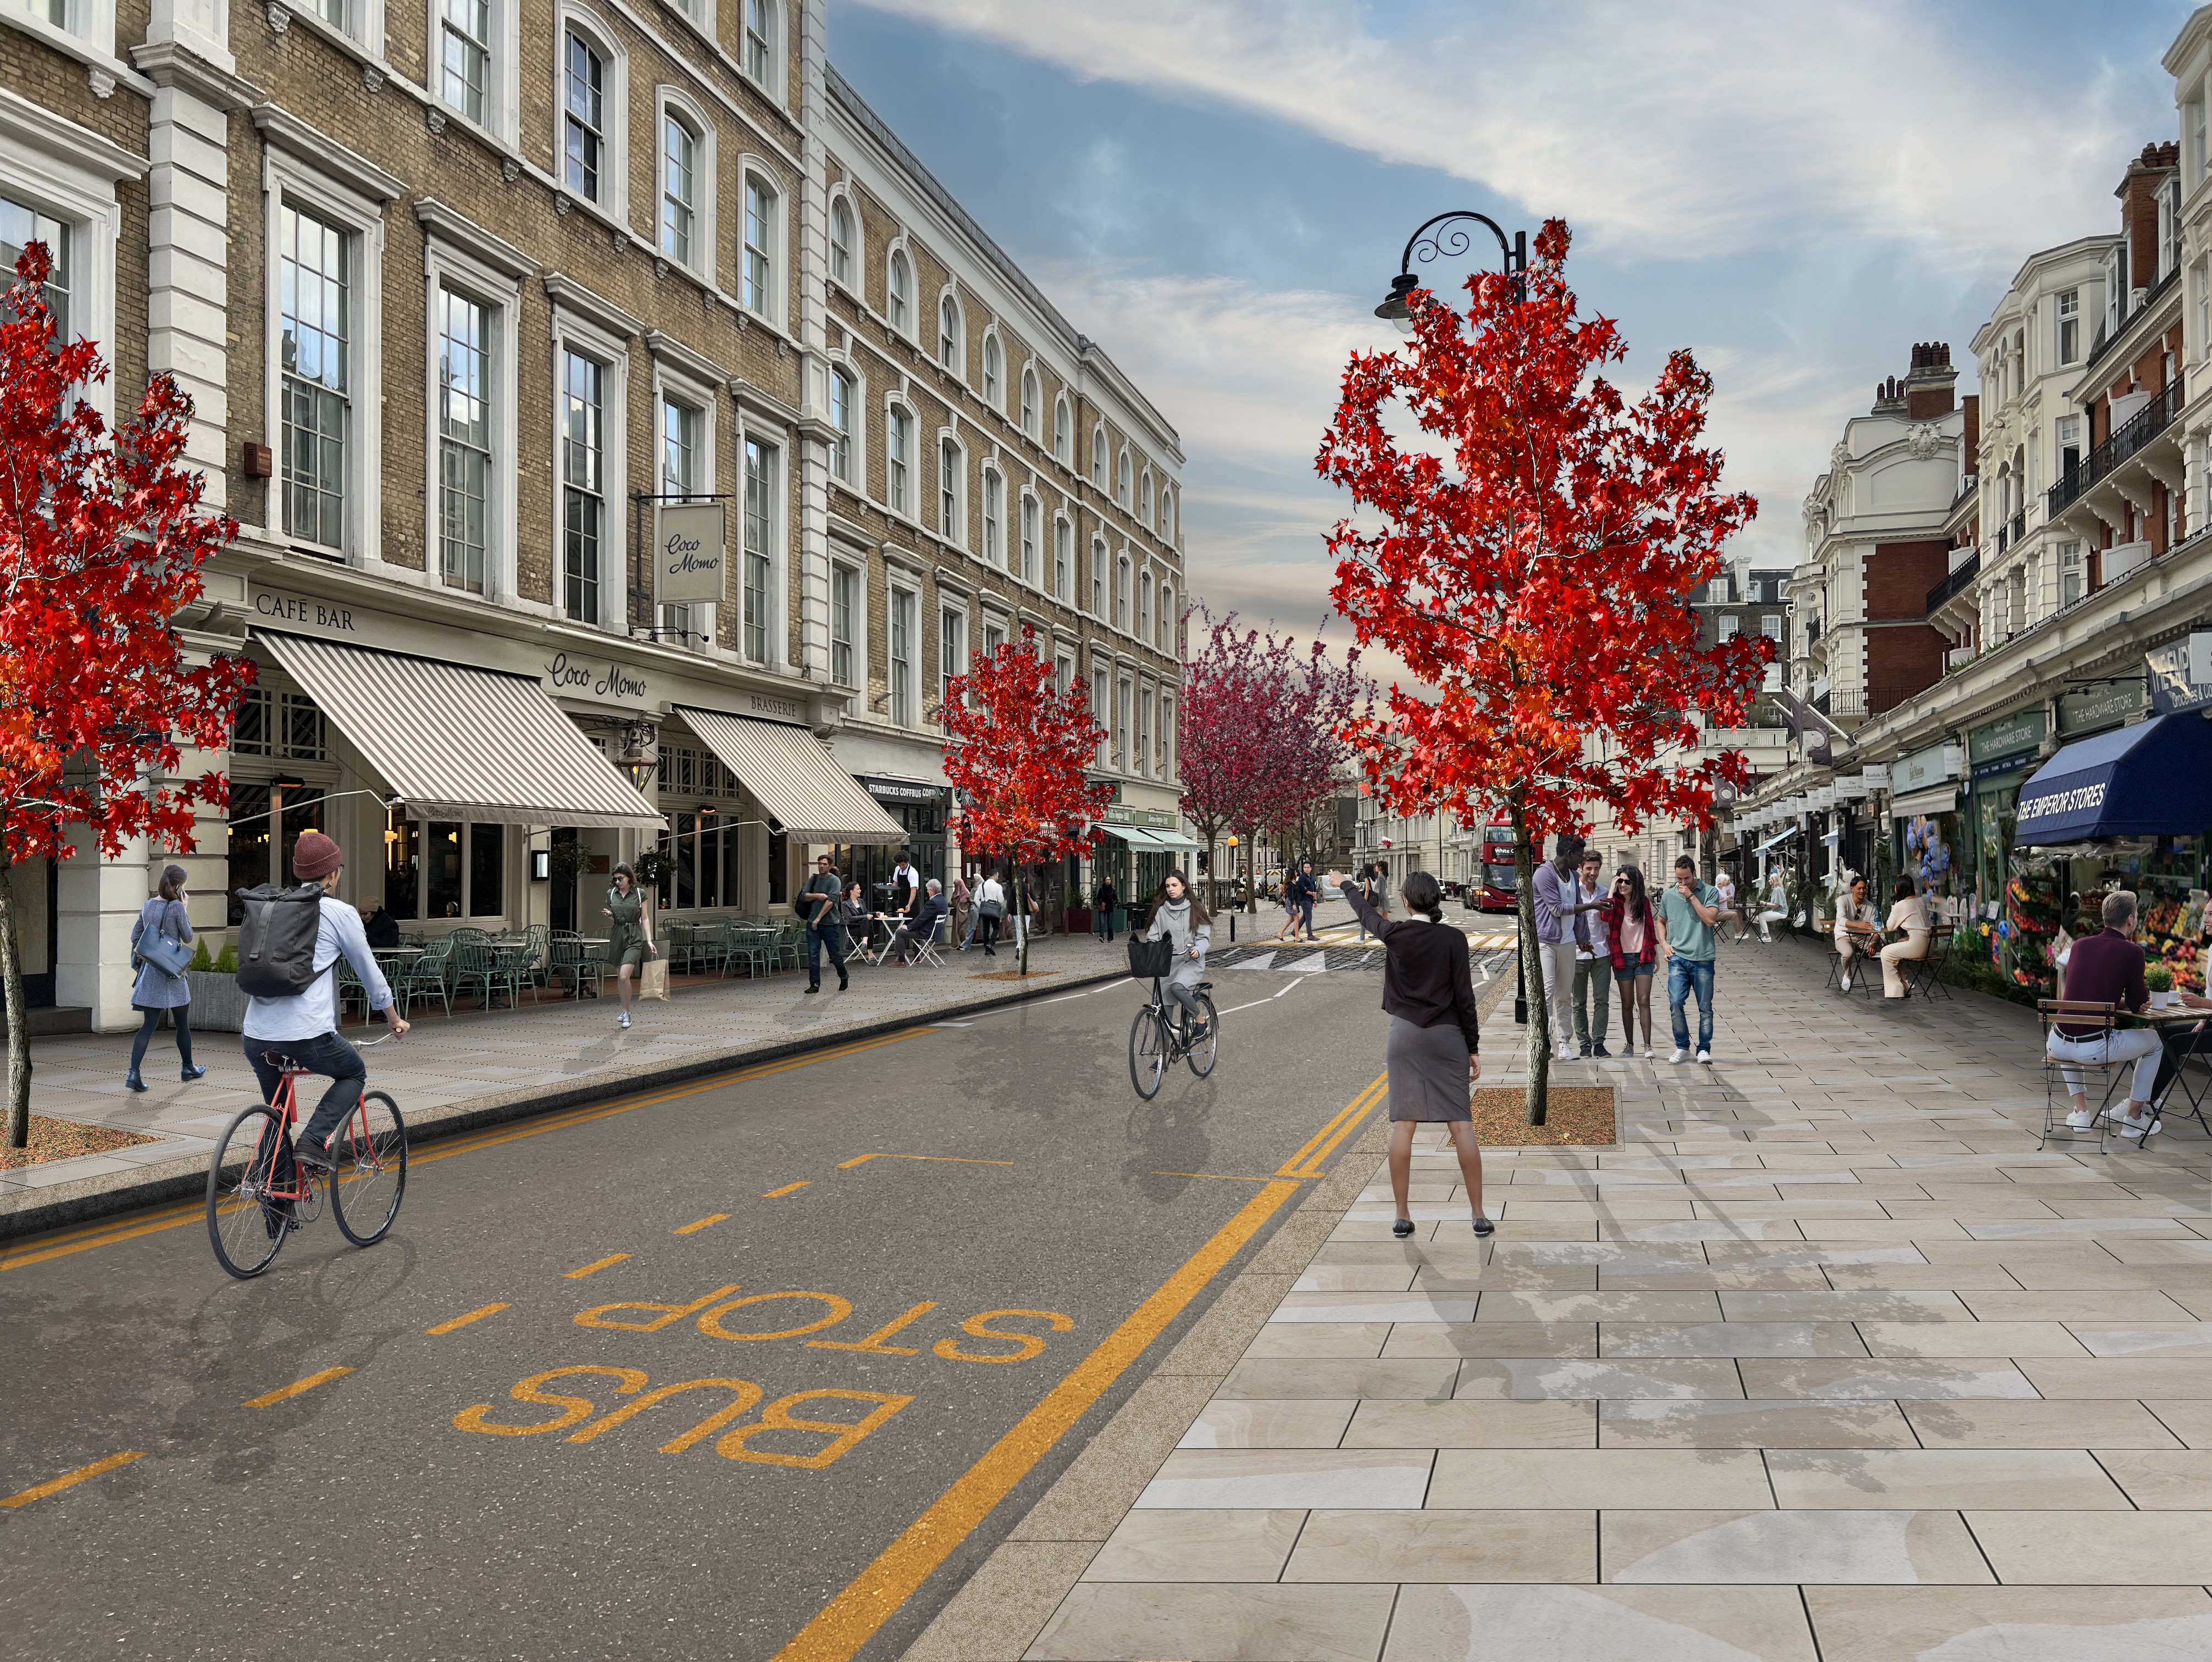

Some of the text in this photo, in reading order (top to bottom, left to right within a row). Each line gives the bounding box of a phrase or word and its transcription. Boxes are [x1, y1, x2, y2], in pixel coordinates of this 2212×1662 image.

[664, 534, 701, 555] Coco
[669, 553, 719, 574] Momo
[256, 594, 355, 631] CAFÉ BAR
[544, 652, 646, 697] Coco Momo
[751, 696, 796, 717] BRASSERIE
[869, 784, 899, 796] STARBUCKS
[2017, 782, 2106, 821] THE EMPEROR STORES
[573, 1284, 1074, 1364] STOP
[453, 1365, 916, 1470] BUS
